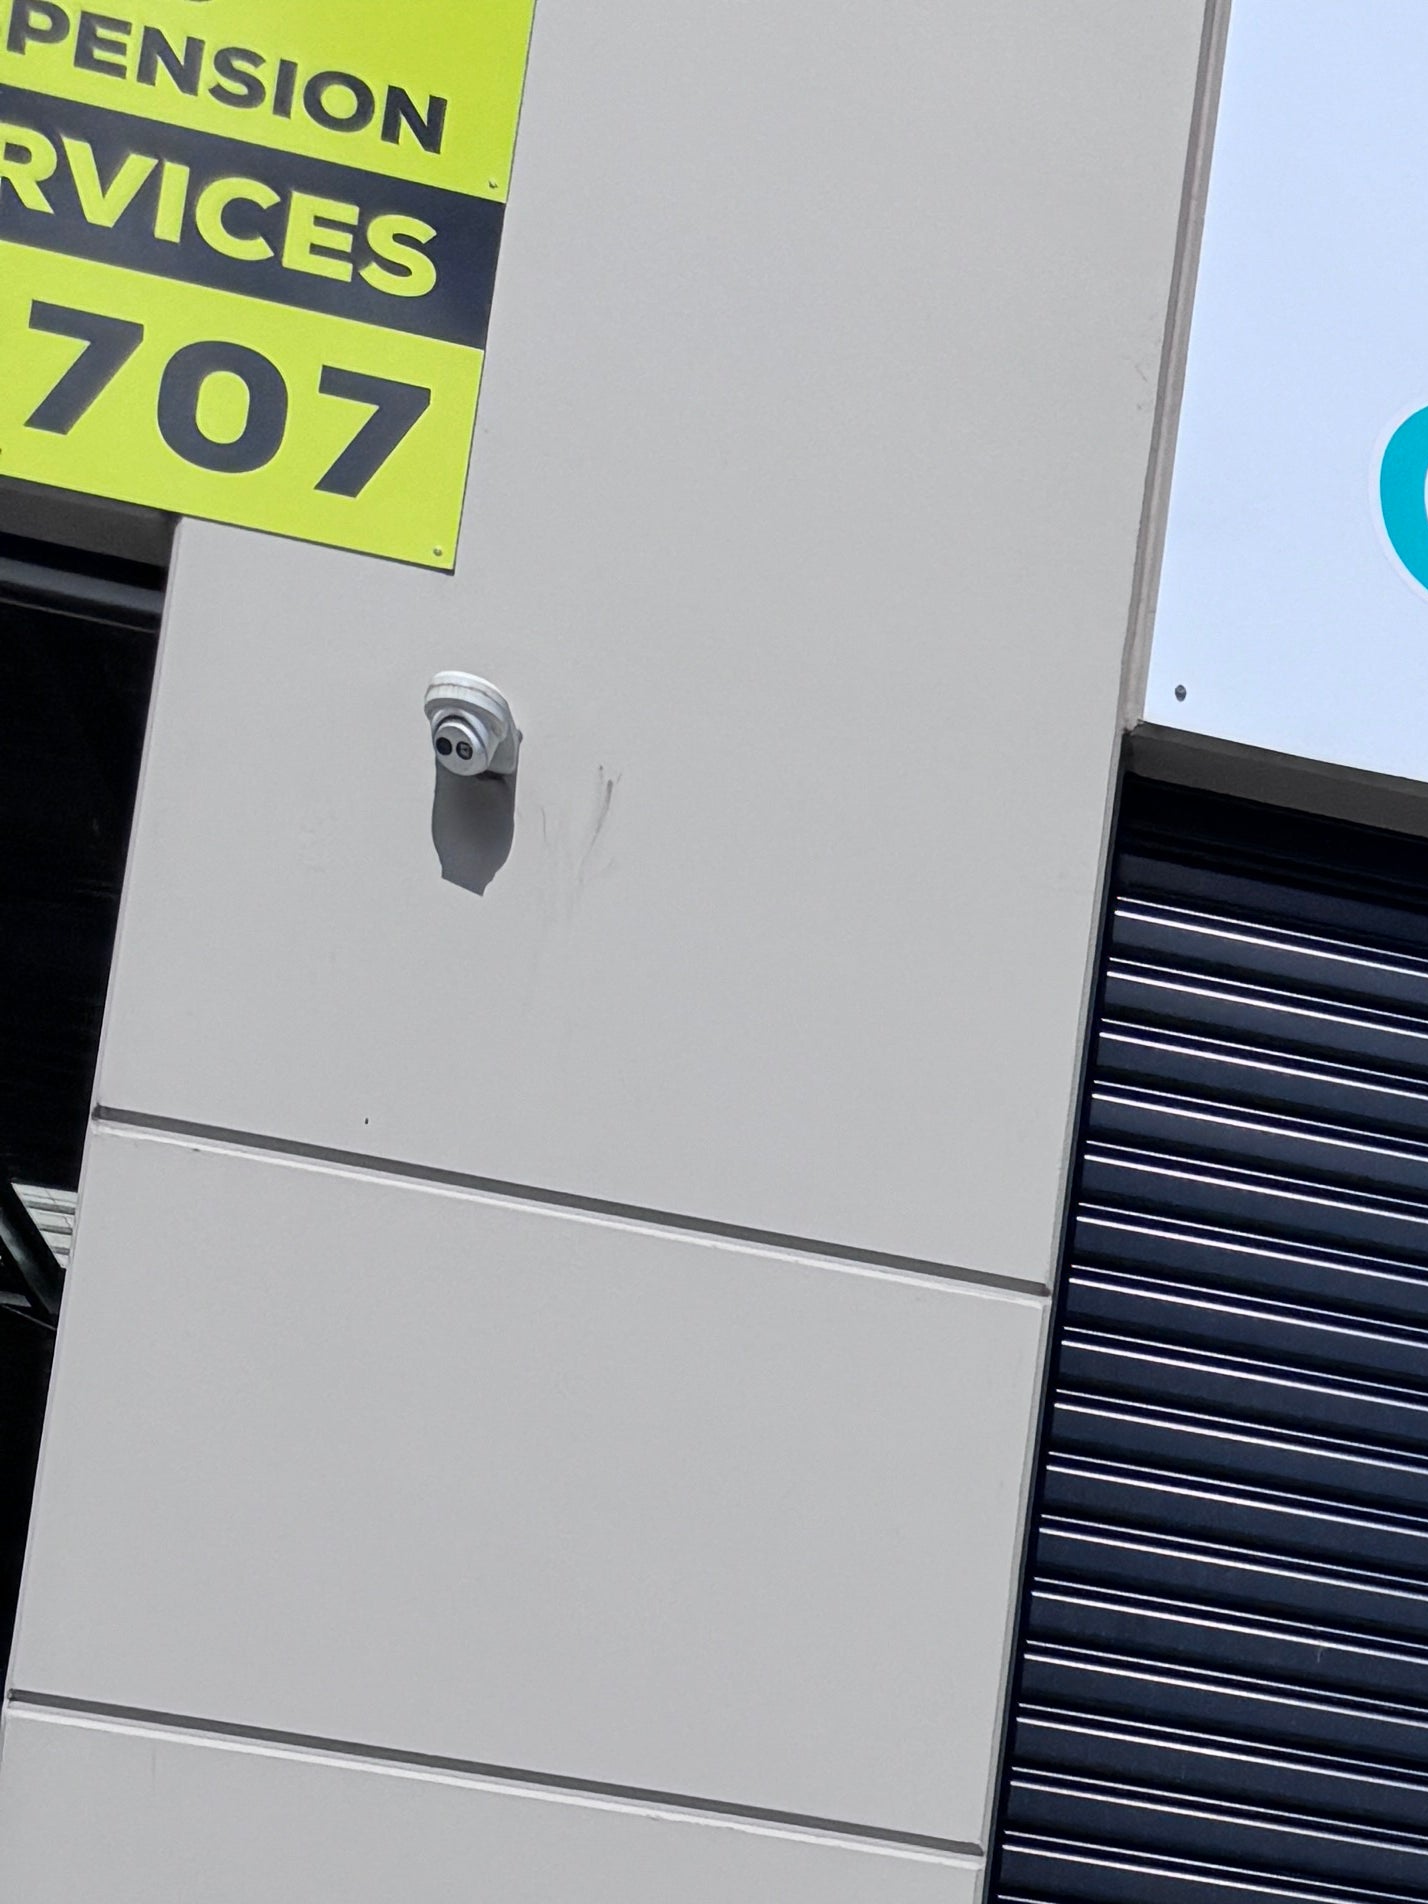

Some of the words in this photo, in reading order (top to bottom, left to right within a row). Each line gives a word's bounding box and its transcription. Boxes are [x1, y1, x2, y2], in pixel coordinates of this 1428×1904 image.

[7, 0, 447, 154] PENSION
[0, 123, 437, 297] RVICES
[24, 299, 431, 498] 707
